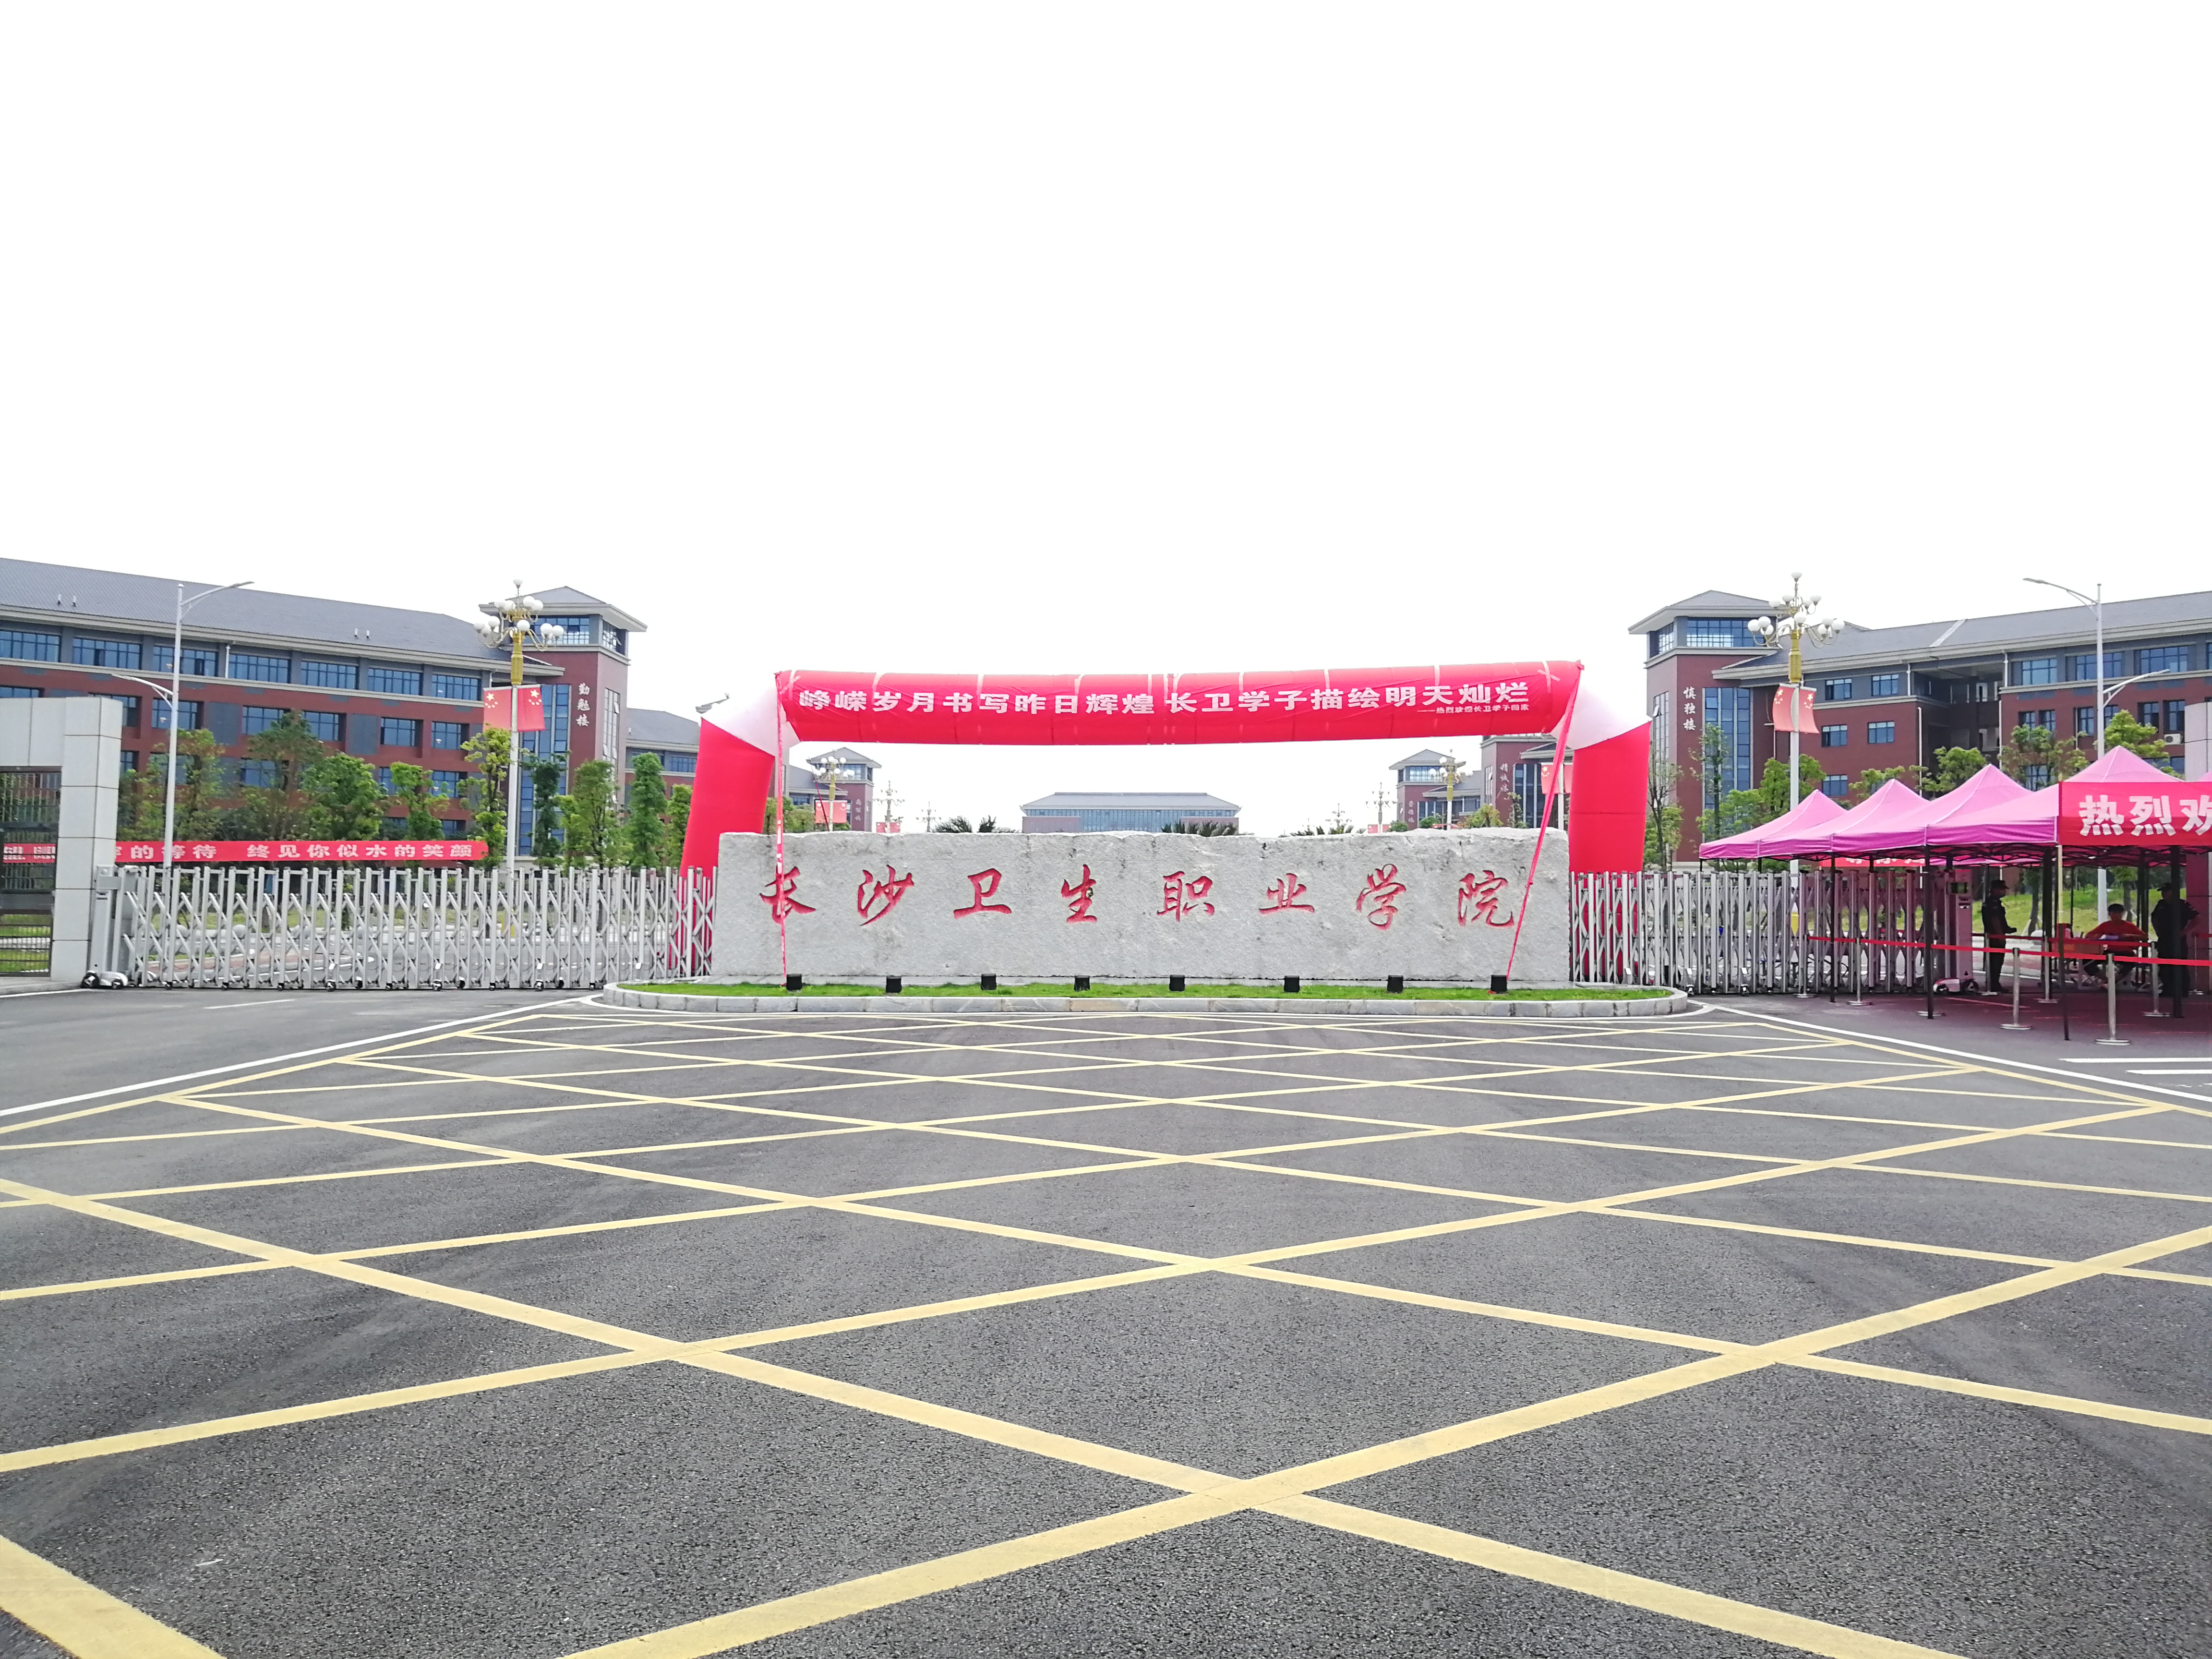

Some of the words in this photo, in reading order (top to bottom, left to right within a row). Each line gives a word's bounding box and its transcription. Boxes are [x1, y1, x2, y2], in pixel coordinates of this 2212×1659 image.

[1683, 686, 1696, 731] 慎独楼
[2078, 794, 2212, 836] 热烈欢
[115, 844, 216, 859] 的等待
[247, 844, 472, 858] 终见你似水的笑颜
[759, 864, 1515, 930] 长沙卫生职业学院
